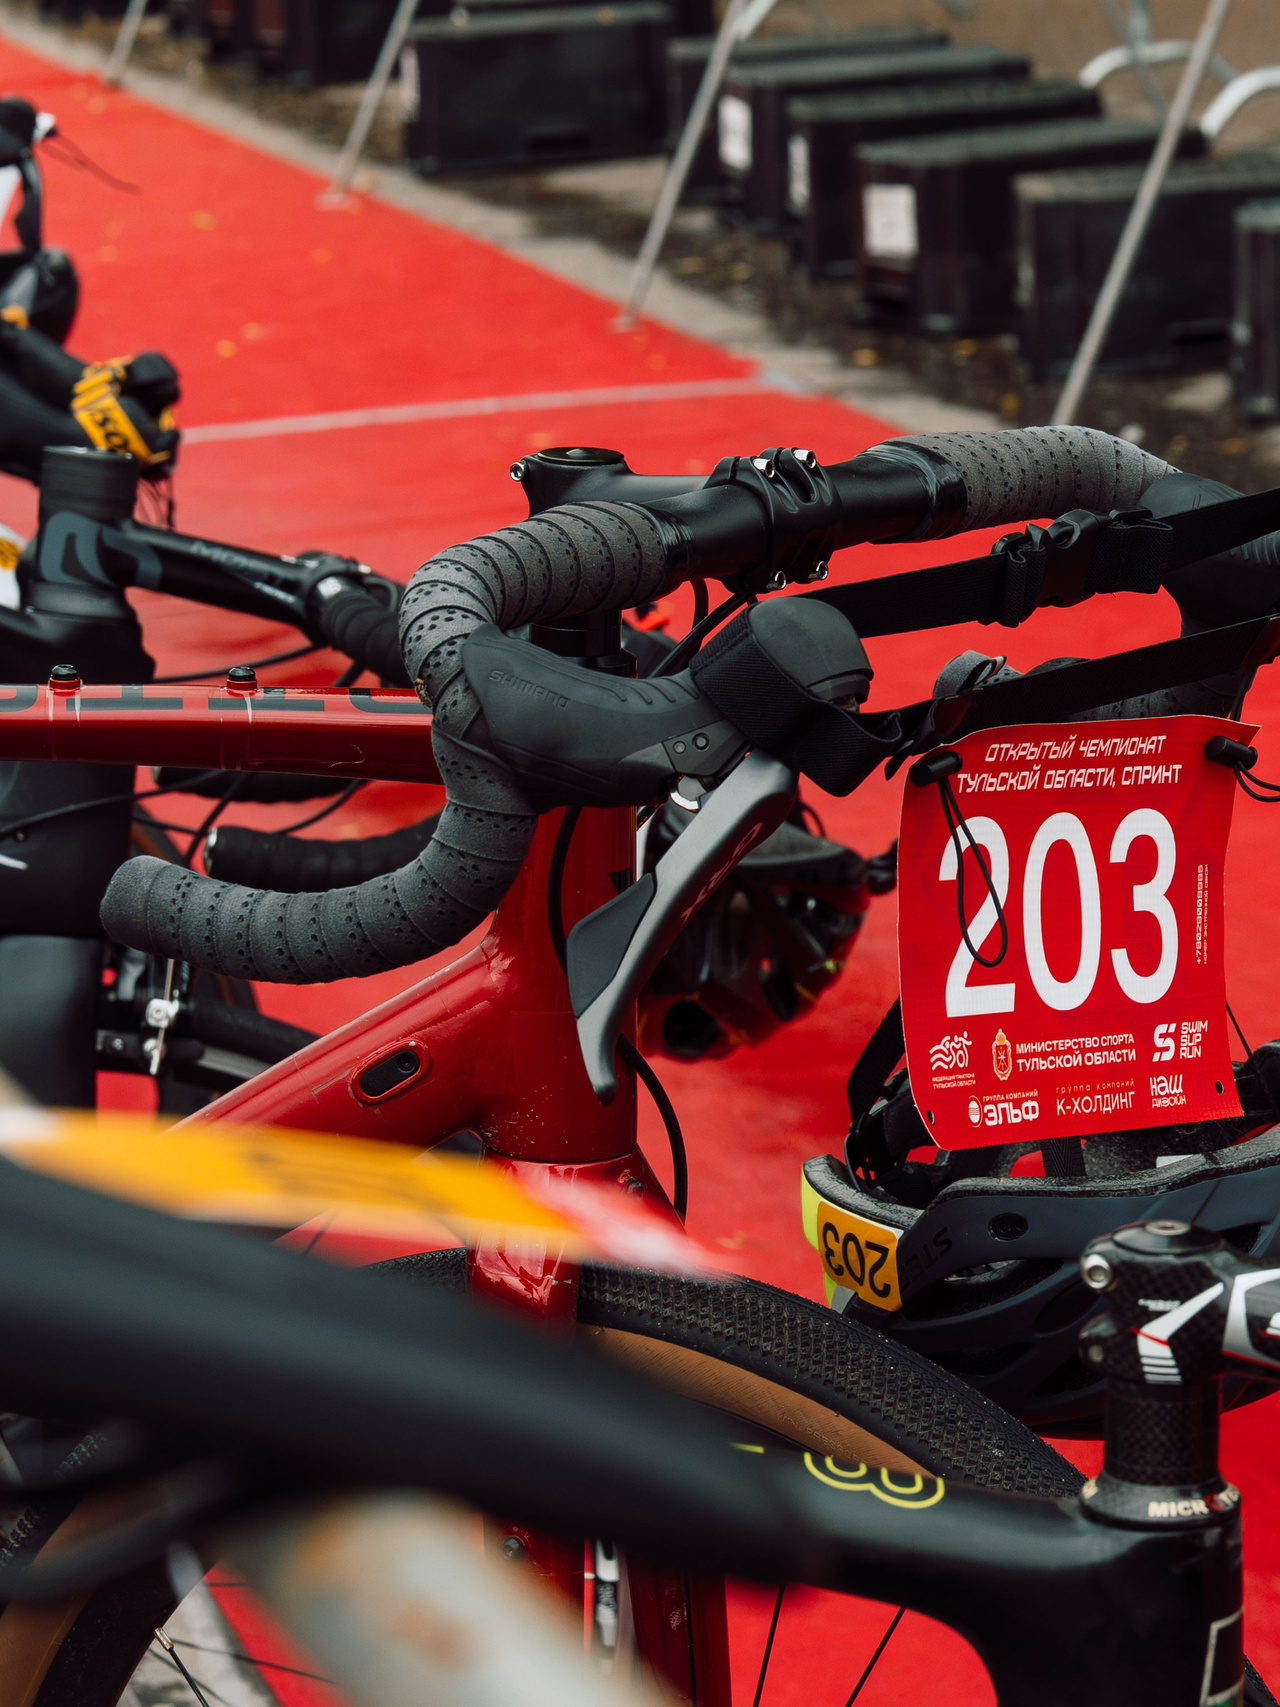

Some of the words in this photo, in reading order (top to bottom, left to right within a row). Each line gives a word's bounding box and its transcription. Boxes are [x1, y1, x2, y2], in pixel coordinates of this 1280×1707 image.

[488, 668, 572, 710] SHIMANO
[984, 733, 1077, 763] ОТКРЫТЫЙ
[1079, 735, 1168, 757] ЧЕМПИОНАТ
[957, 764, 1041, 793] ТУЛЬСКОЙ
[1043, 767, 1117, 790] ОБЛАСТИ,
[1121, 764, 1182, 785] СПРИНТ
[939, 808, 1178, 1017] 203
[1180, 1020, 1208, 1035] SWIM
[1180, 1033, 1202, 1047] SUP
[1016, 1036, 1100, 1055] МИНИСТЕРСТВО
[1101, 1033, 1135, 1047] СПОРТА
[1179, 1045, 1202, 1060] RUN
[1016, 1050, 1082, 1072] ТУЛЬСКОЙ
[1084, 1048, 1137, 1066] ОБЛАСТИ
[982, 1093, 1005, 1103] ГРУППА
[1005, 1088, 1039, 1101] КОМПАНИЙ
[1056, 1090, 1135, 1116] К-ХОЛДИНГ
[983, 1099, 1040, 1127] ЭЛЬФ
[822, 1222, 891, 1299] 203
